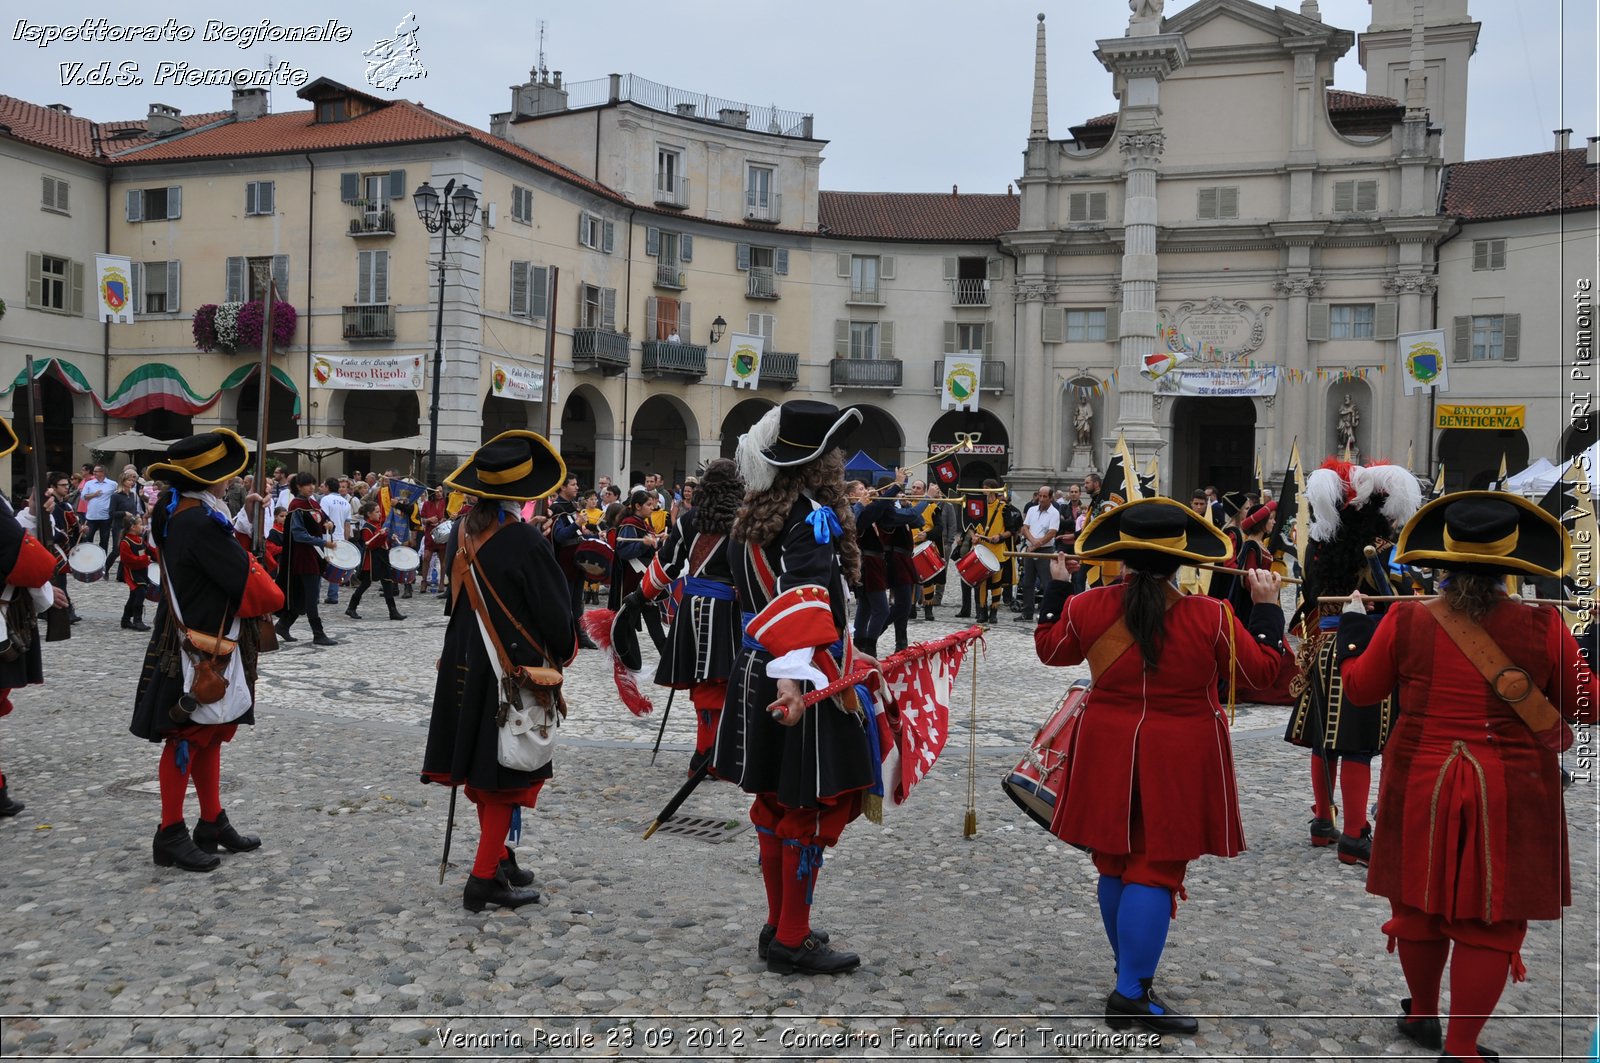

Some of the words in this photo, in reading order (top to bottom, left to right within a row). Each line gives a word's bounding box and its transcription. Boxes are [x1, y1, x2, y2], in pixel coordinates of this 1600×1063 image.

[336, 368, 367, 380] Borgo
[370, 368, 407, 380] Rigola
[1181, 371, 1209, 379] Parrocchia
[1211, 387, 1217, 395] di
[1217, 387, 1257, 395] Consacrazione
[1439, 416, 1520, 427] BENEFICENZA
[963, 445, 1003, 453] OTTICA
